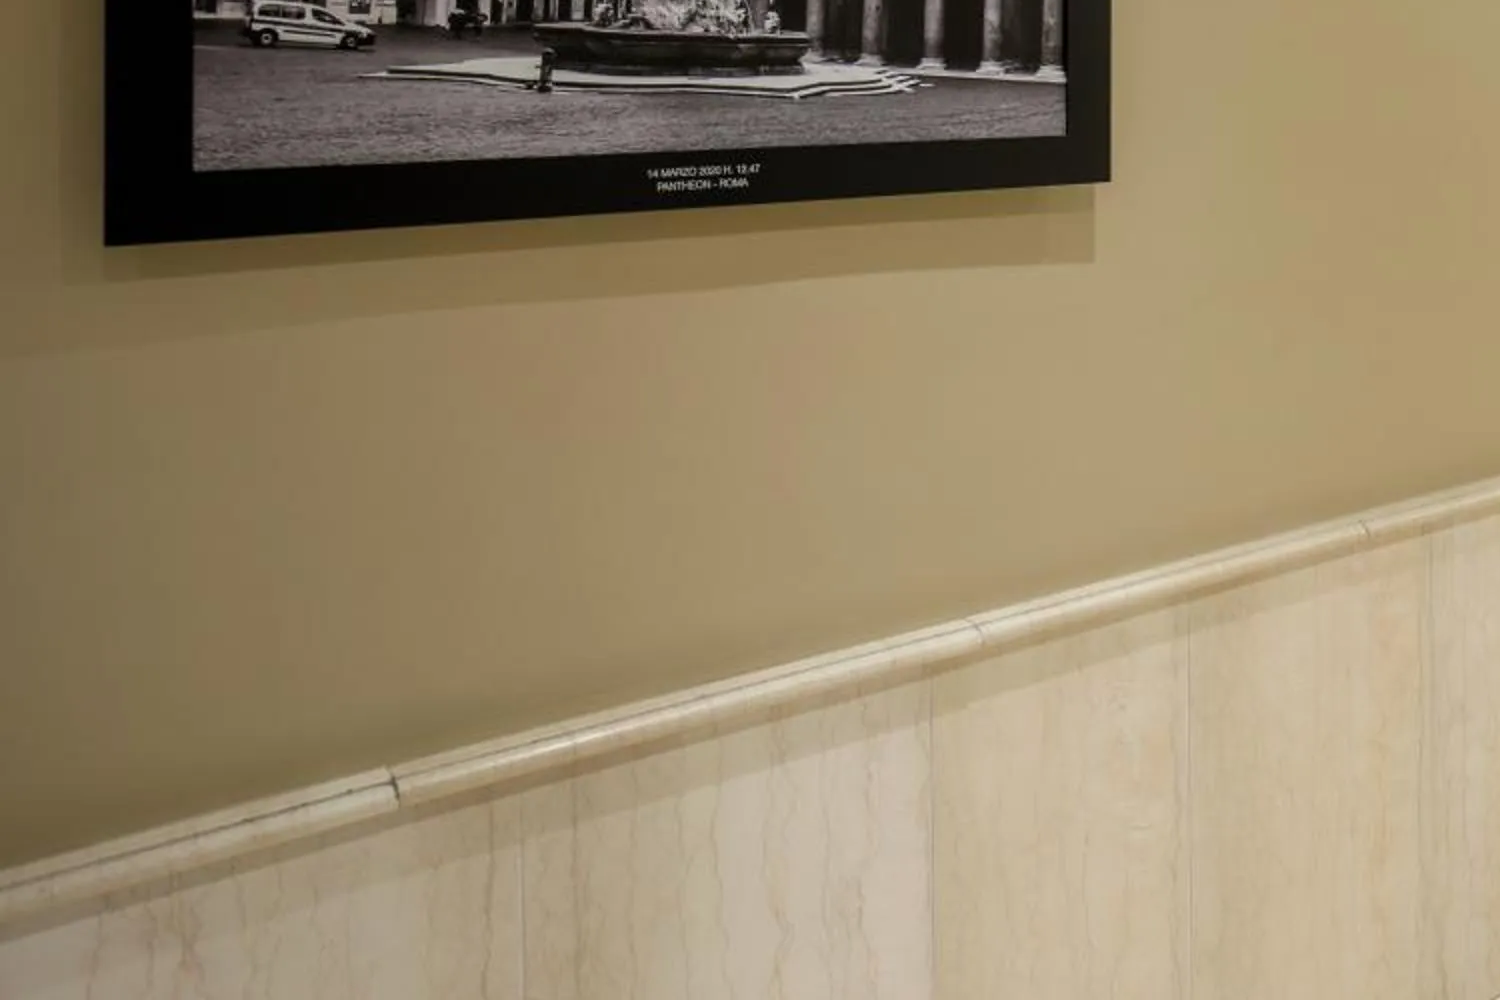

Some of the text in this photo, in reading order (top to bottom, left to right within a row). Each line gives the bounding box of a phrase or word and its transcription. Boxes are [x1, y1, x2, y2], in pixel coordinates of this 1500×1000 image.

[660, 166, 697, 178] MARZO
[656, 179, 711, 192] PANTHEON
[719, 177, 749, 188] ROMA
